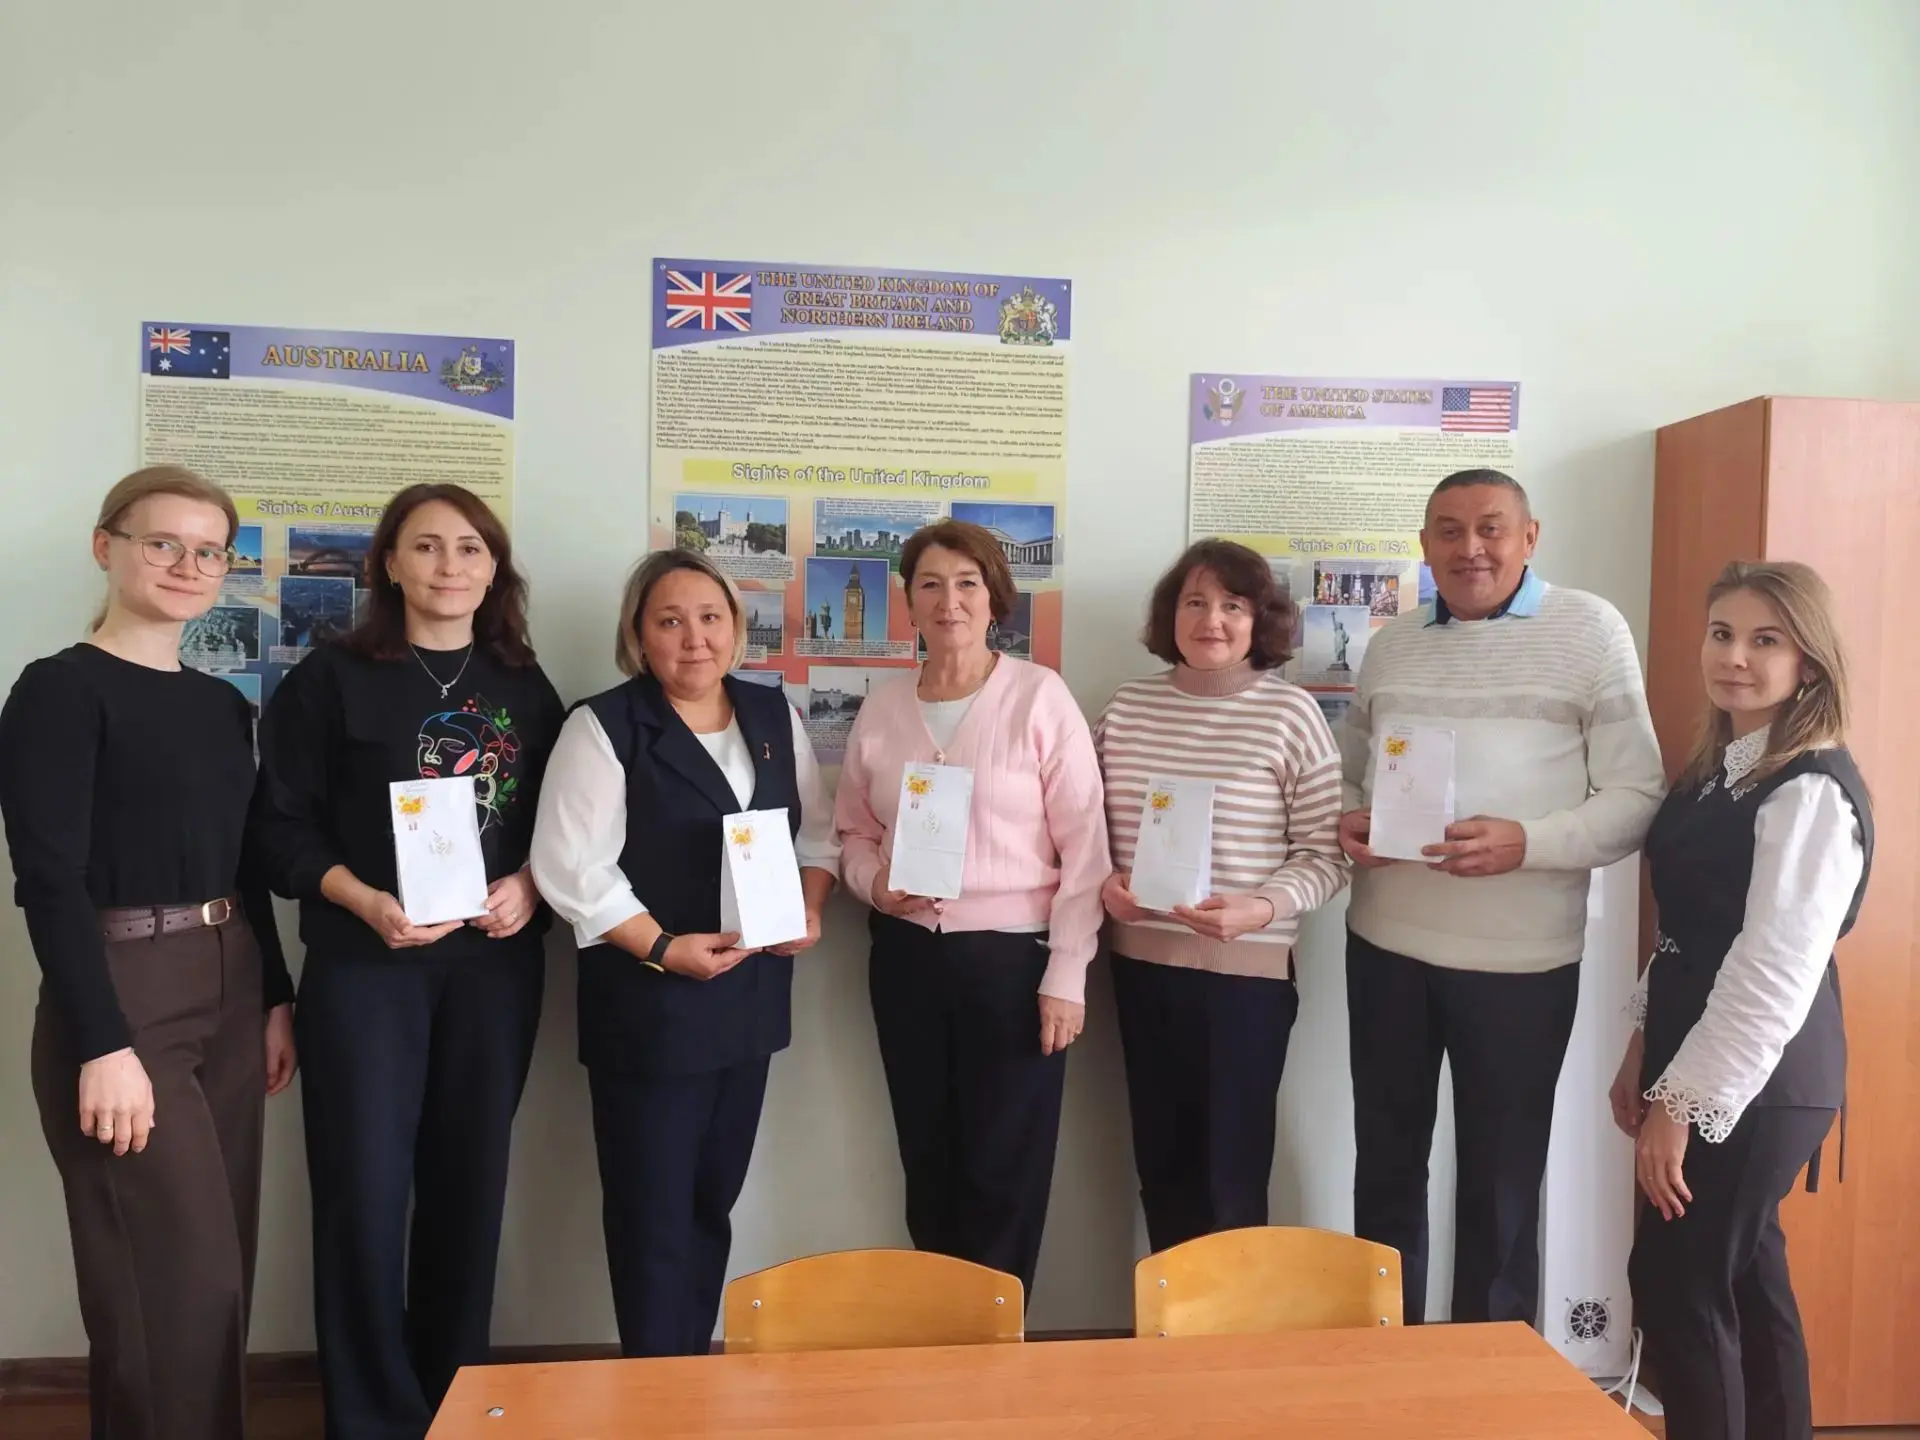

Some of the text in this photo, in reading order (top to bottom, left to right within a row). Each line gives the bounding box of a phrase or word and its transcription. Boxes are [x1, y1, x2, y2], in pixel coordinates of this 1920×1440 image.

[757, 271, 1001, 298] THE UNITED KINGDOM OF
[784, 291, 972, 315] GREAT BRITAIN AND
[781, 308, 975, 332] NORTHERN IRELAND
[262, 344, 431, 373] AUSTRALIA
[1261, 385, 1434, 404] THE UNITED STATES
[1259, 403, 1367, 419] OF AMERICA
[732, 463, 992, 490] Sights of the United Kingdom
[256, 499, 308, 515] Sights
[311, 502, 329, 515] of
[1289, 537, 1410, 554] Sights of the USA
